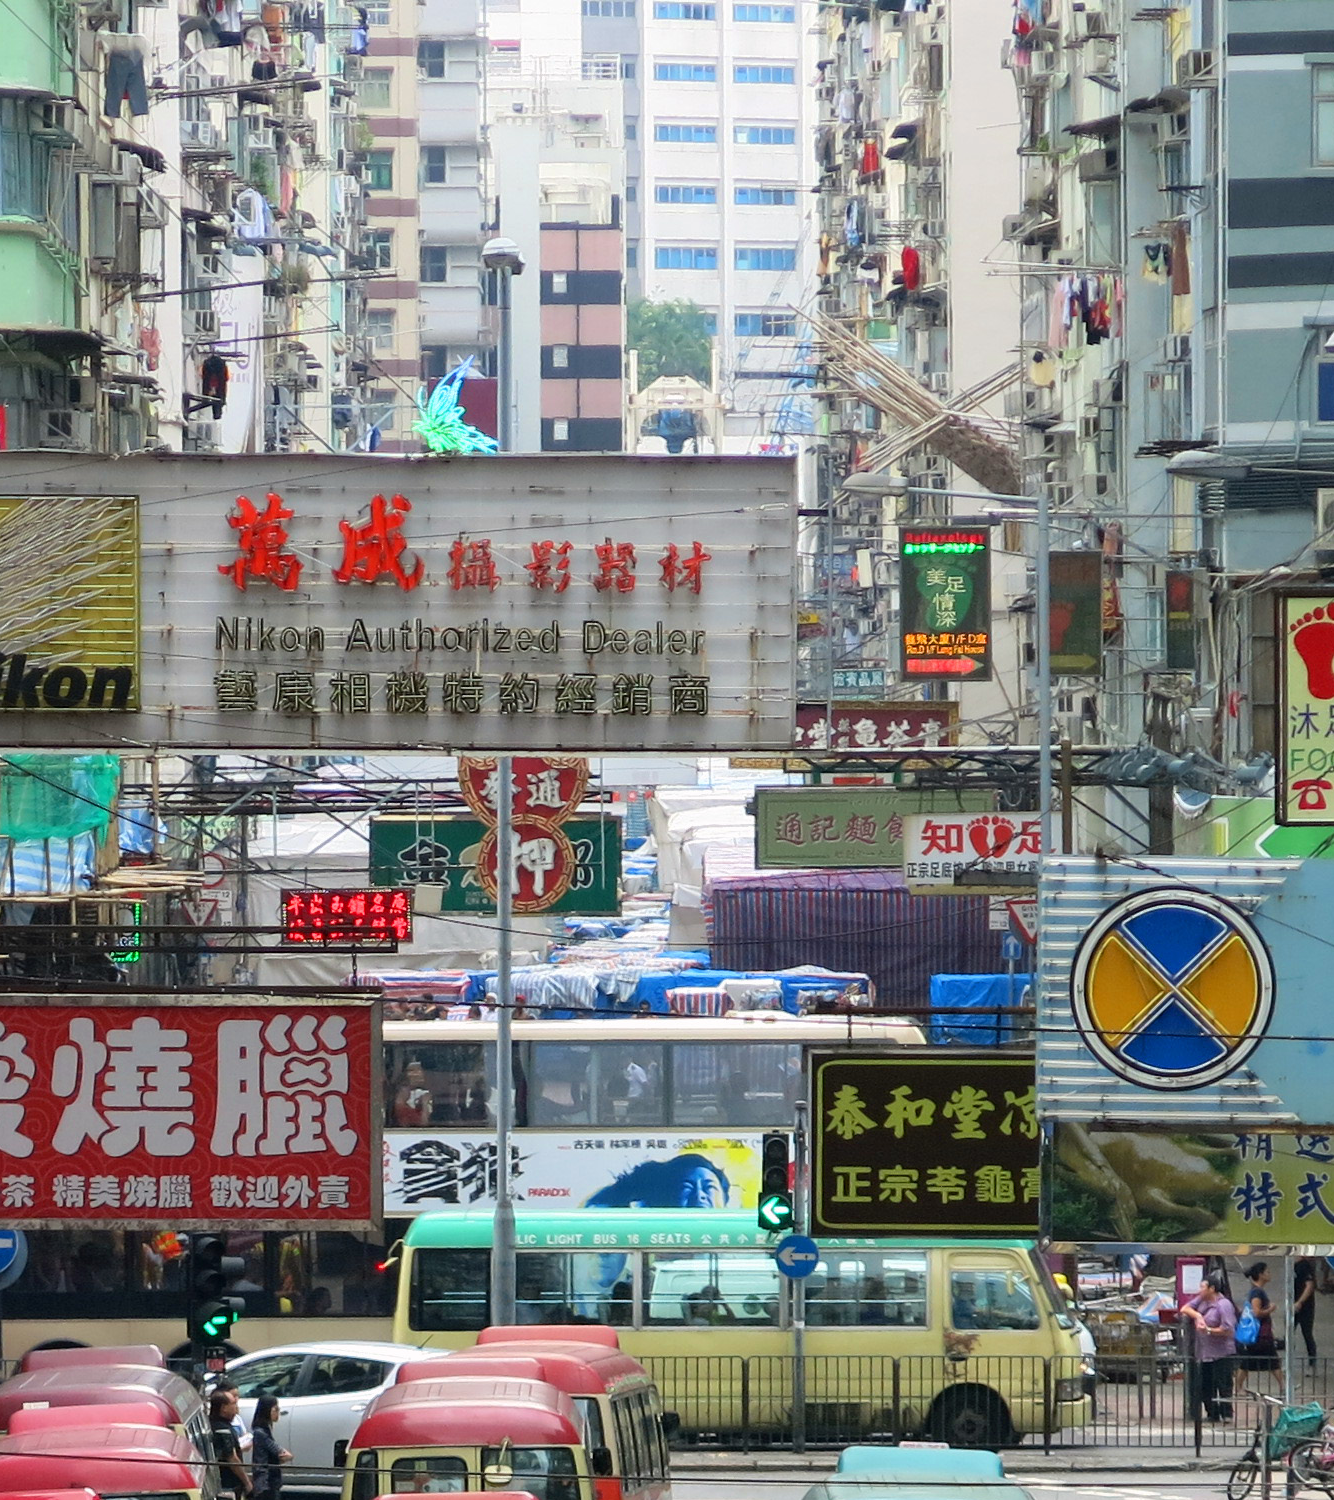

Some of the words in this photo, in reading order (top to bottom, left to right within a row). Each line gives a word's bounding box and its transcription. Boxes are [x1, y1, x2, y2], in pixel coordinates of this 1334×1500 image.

[447, 537, 712, 594] 攝影器材
[216, 616, 325, 652] Nikon
[346, 618, 560, 653] Authorized
[583, 620, 707, 655] Dealer
[214, 669, 709, 715] 藝康相機特約經銷商
[52, 1174, 193, 1209] 精美燒臘
[210, 1174, 349, 1209] 歡迎外賣
[546, 1234, 583, 1245] LIGHT
[593, 1234, 618, 1245] BUS
[627, 1234, 640, 1244] 16
[650, 1234, 691, 1244] SEATS
